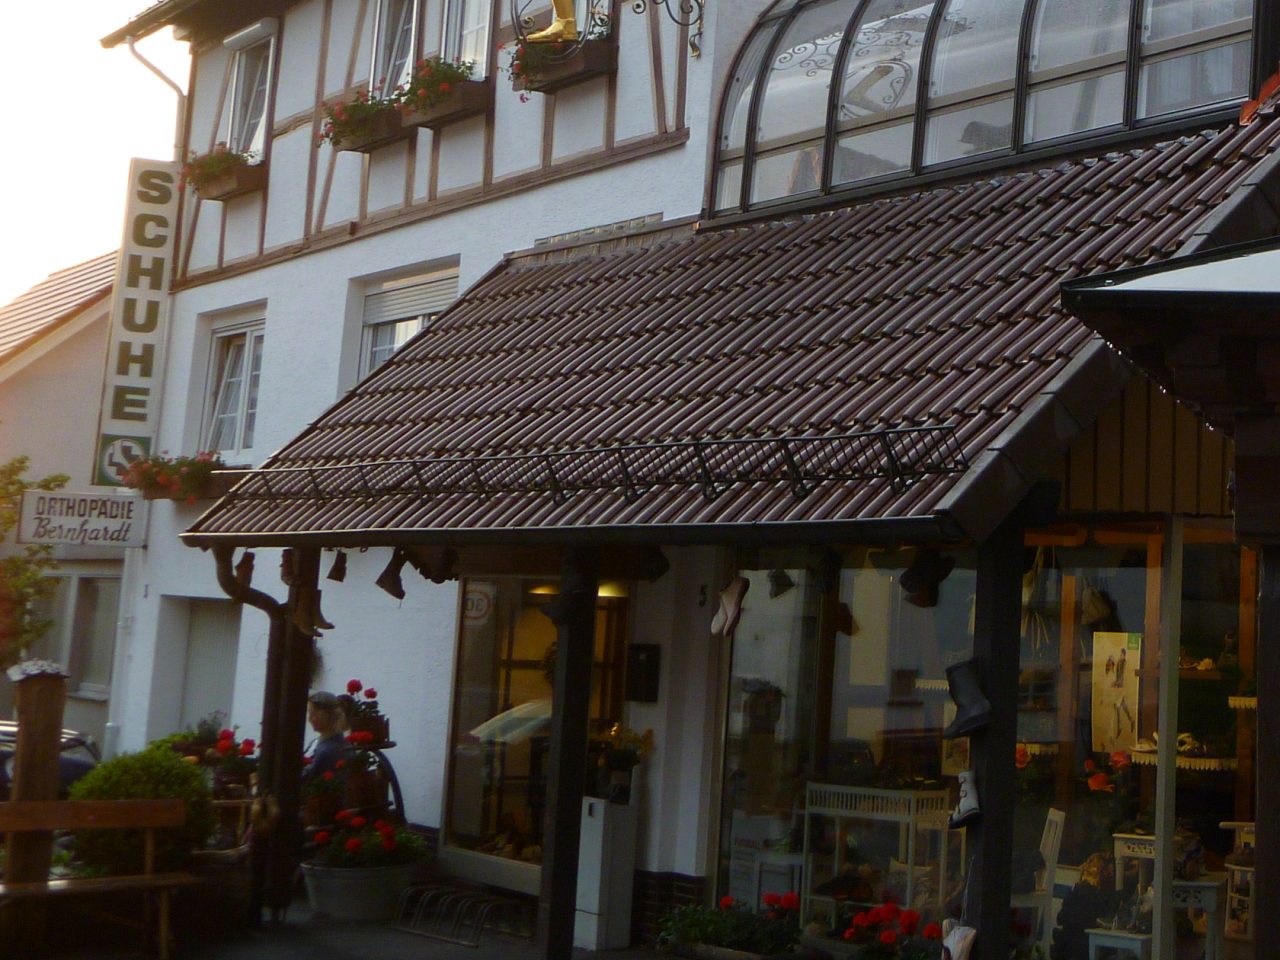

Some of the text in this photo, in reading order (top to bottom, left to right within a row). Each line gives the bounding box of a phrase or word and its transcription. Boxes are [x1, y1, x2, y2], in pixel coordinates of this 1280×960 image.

[111, 169, 174, 422] SCHUHE
[36, 496, 135, 520] ORTHOPÄDIE
[32, 516, 132, 544] Bernhardt
